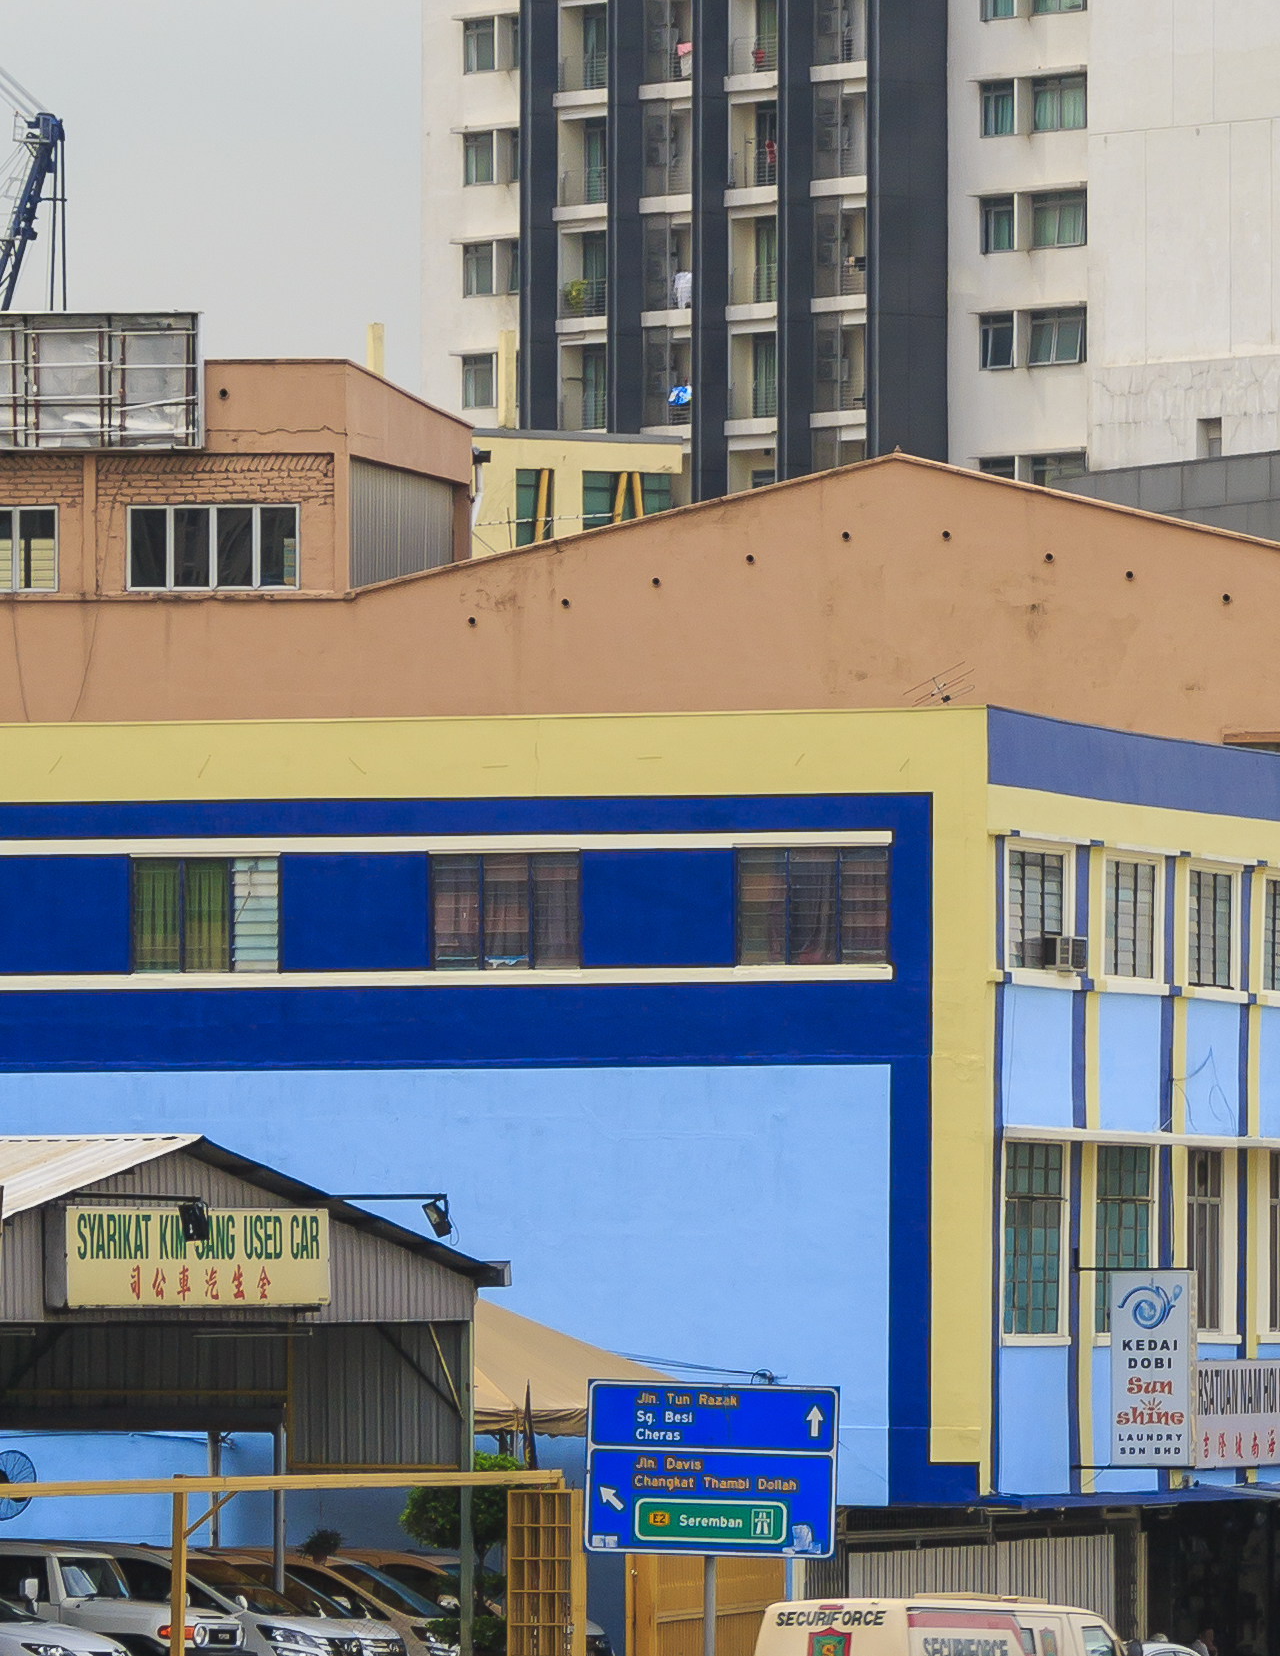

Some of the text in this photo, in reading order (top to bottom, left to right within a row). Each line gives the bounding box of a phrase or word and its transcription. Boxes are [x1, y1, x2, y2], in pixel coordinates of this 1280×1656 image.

[77, 1213, 151, 1260] SYARIKAT
[159, 1214, 187, 1260] KIM
[243, 1214, 283, 1260] USED
[290, 1214, 320, 1259] CAR
[1122, 1339, 1178, 1351] KEDAI
[1127, 1357, 1172, 1369] DOBI
[1127, 1376, 1174, 1395] Sun
[1198, 1369, 1238, 1416] RSATUAN
[1240, 1368, 1262, 1415] NAM
[667, 1393, 690, 1405] Tun
[698, 1395, 738, 1407] Razak
[636, 1410, 693, 1425] Sg. Besi
[1116, 1404, 1184, 1426] shine
[635, 1428, 681, 1441] Cheras
[1118, 1433, 1183, 1442] LAUNDRY
[1119, 1446, 1181, 1455] SDN BHD
[666, 1458, 702, 1470] Davis
[634, 1475, 797, 1491] Changkat Thambi Dollah
[652, 1513, 743, 1528] E2 Seremban
[775, 1610, 887, 1627] SECURIFORCE
